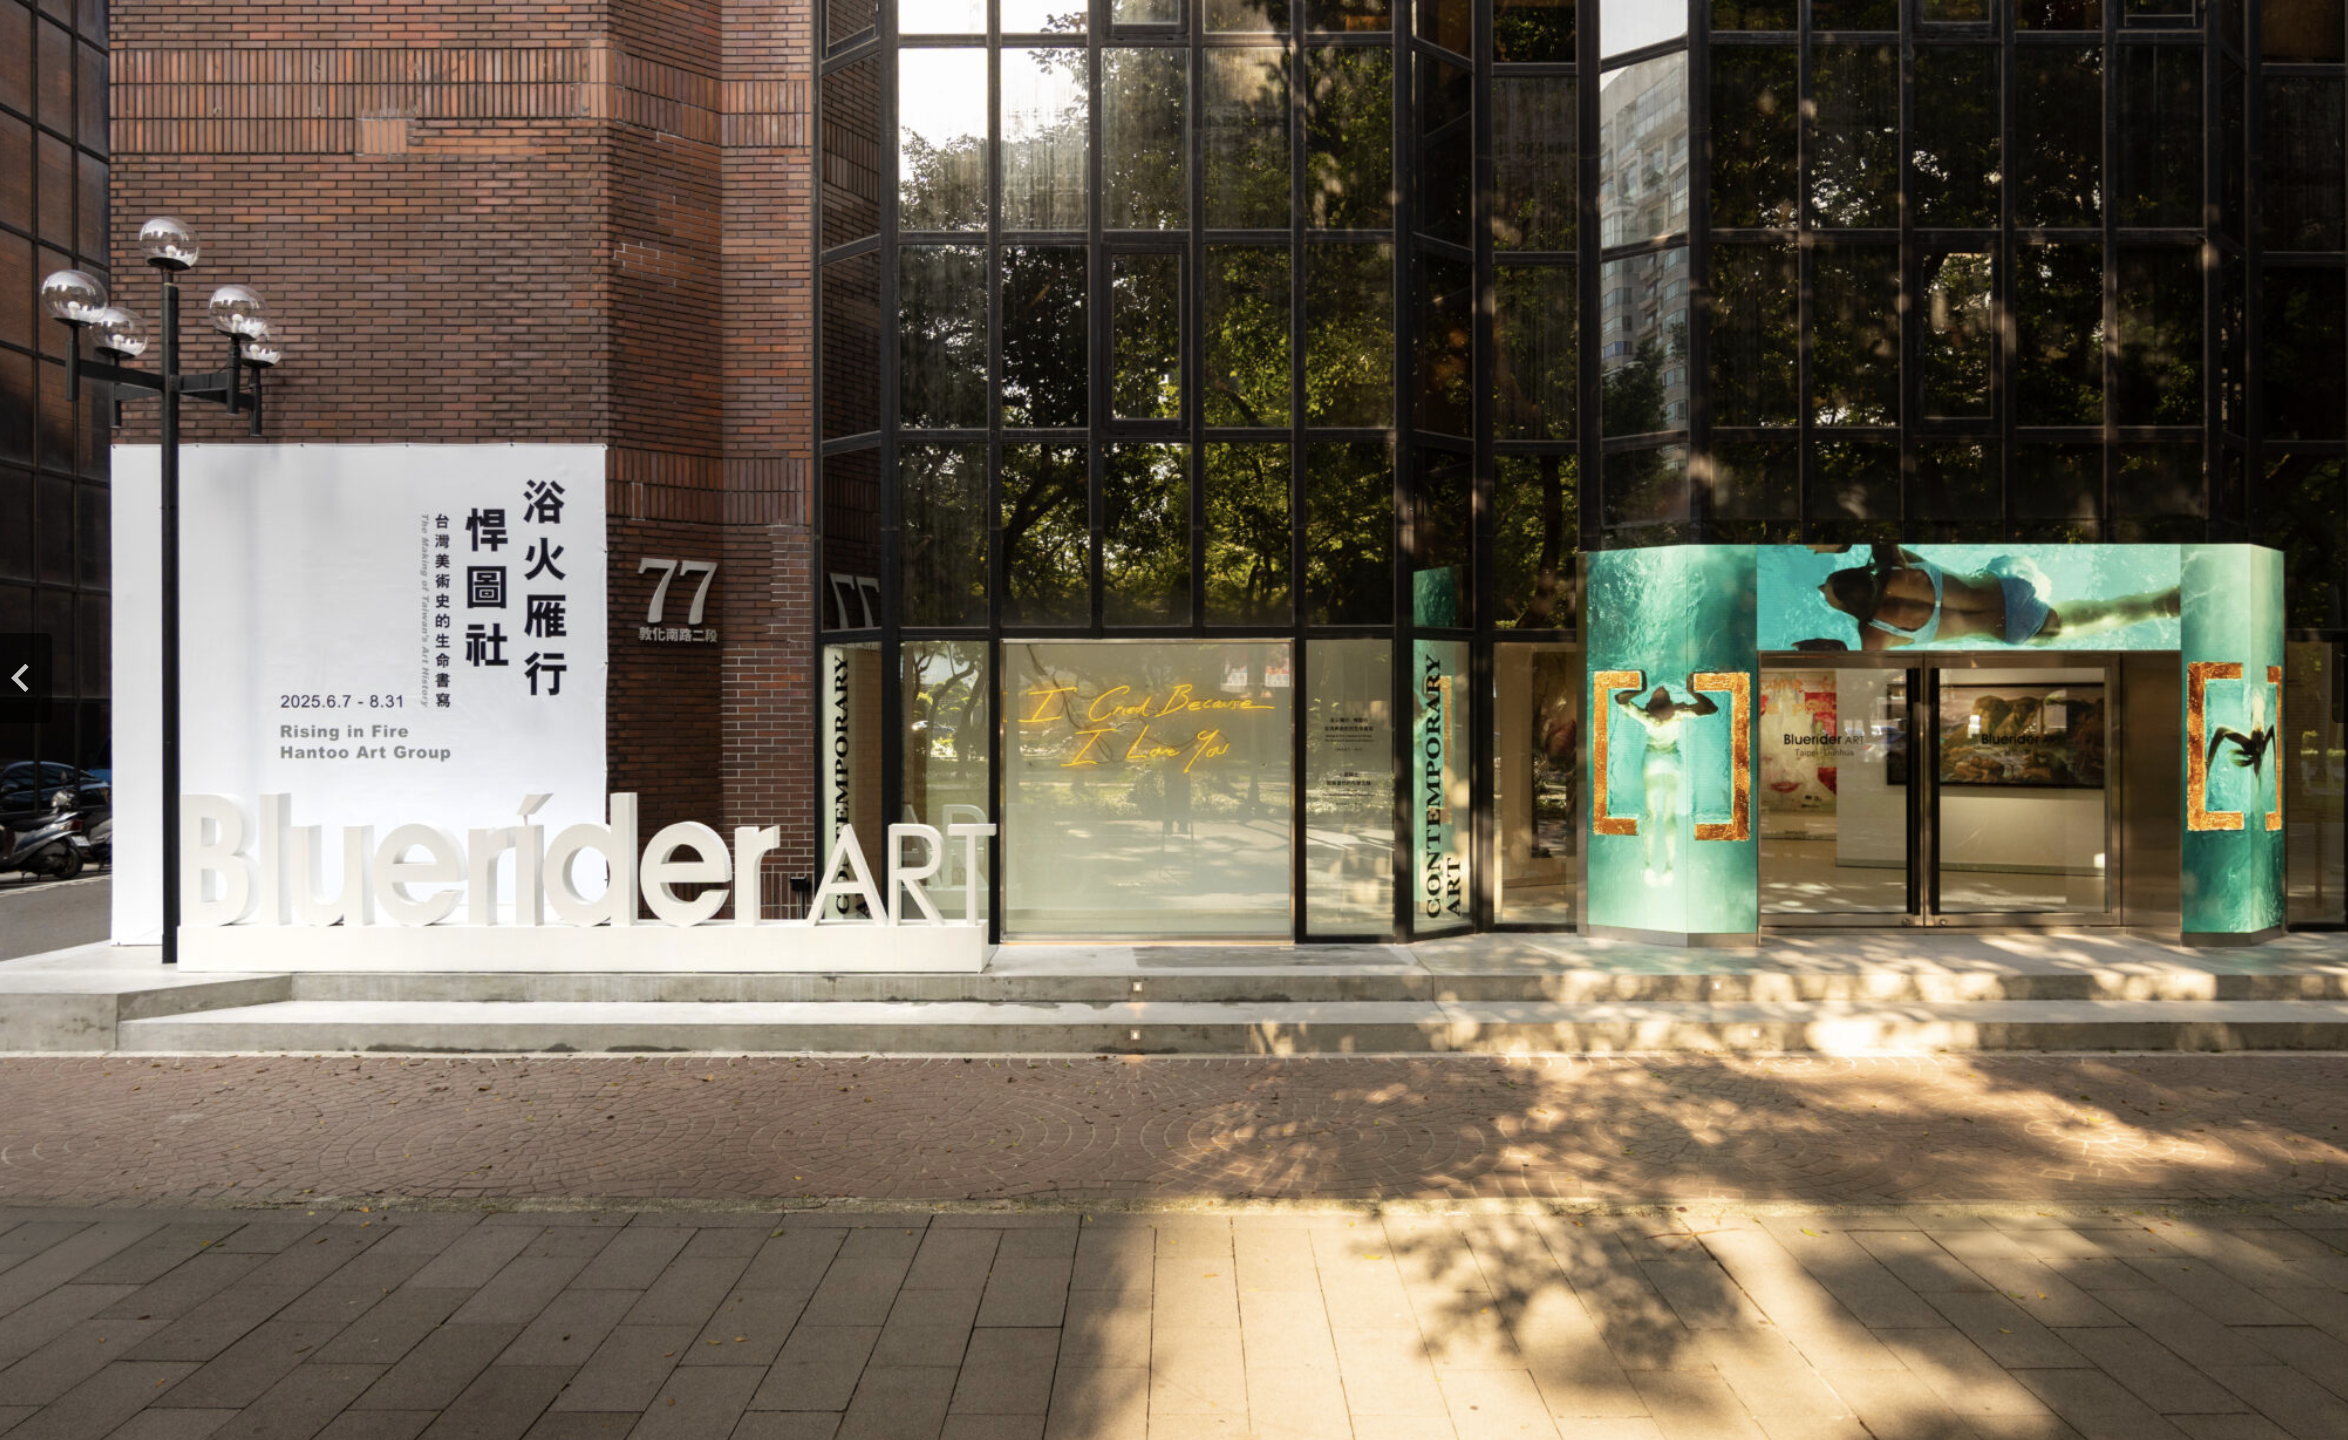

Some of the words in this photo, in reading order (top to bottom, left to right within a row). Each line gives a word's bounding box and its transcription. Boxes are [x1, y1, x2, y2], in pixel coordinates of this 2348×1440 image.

[421, 514, 429, 534] The
[420, 536, 429, 577] Making
[421, 579, 429, 592] of
[465, 508, 509, 667] 悍圖社
[523, 479, 567, 696] 浴火雁行
[638, 557, 718, 625] 77
[421, 595, 429, 643] Taiwan's
[435, 513, 451, 709] 台灣美術史的生命書寫
[638, 626, 718, 643] 敦化南路二段
[421, 646, 430, 665] Art
[280, 694, 351, 709] 2025.6.7
[369, 694, 404, 709] 8.31
[420, 667, 430, 708] History
[1018, 687, 1077, 722] I
[1154, 684, 1275, 718] Because
[280, 725, 340, 741] Rising
[347, 725, 364, 738] in
[371, 725, 409, 738] Fire
[1061, 728, 1117, 767] I
[1126, 724, 1180, 759] Love
[1184, 729, 1230, 773] You
[1844, 736, 1864, 745] ART
[280, 746, 350, 759] Hantoo
[357, 746, 385, 759] Art
[393, 746, 451, 762] Group
[1426, 654, 1440, 919] CONTEMPORARY
[804, 823, 997, 927] ART
[1447, 857, 1461, 917] ART
